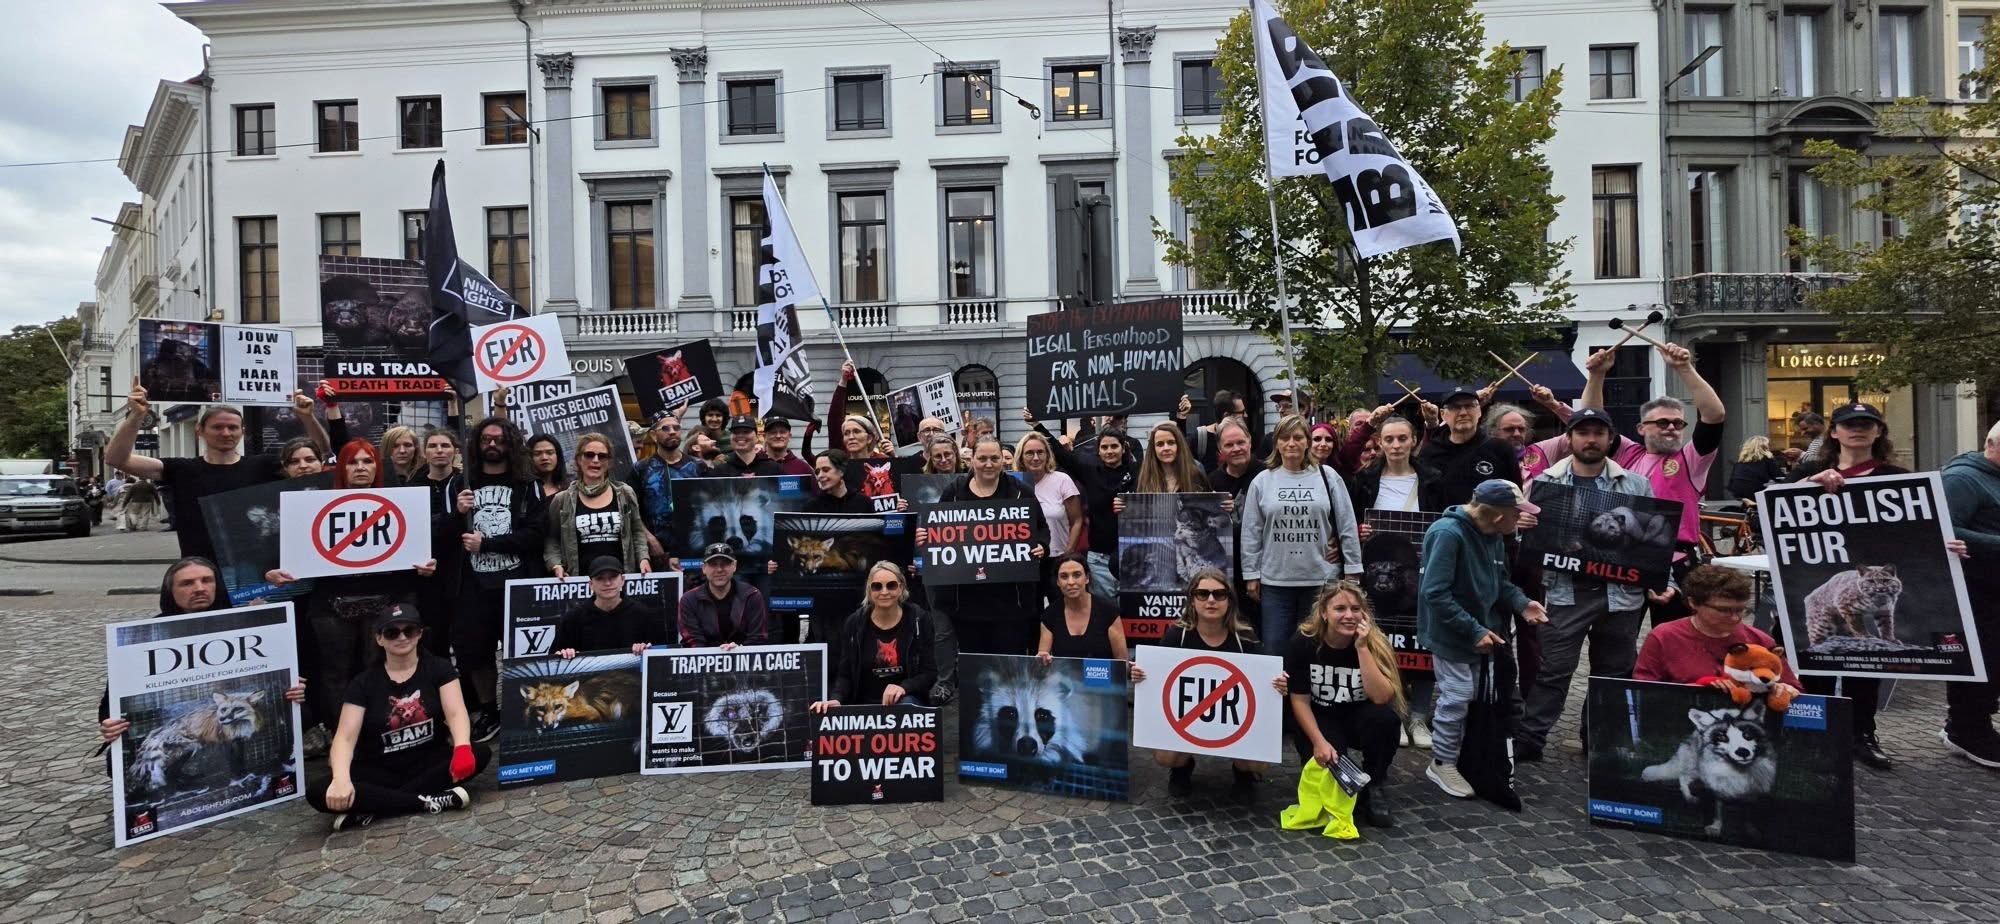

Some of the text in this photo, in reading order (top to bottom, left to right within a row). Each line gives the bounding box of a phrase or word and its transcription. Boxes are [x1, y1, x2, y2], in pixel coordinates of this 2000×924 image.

[238, 330, 279, 342] JOUW
[1029, 332, 1077, 357] LEGAL
[246, 343, 271, 355] JAS
[485, 336, 536, 370] FUR
[337, 362, 440, 375] FUR TRAD
[1051, 347, 1181, 382] FOR NON-HUMAN
[240, 368, 279, 380] HAAR
[239, 381, 281, 392] LEVEN
[338, 380, 441, 390] DEATH TRADE
[665, 382, 696, 401] BAM
[925, 380, 945, 393] JOUW
[931, 391, 943, 400] JAS
[530, 403, 566, 422] FOXES
[568, 393, 612, 411] BELONG
[542, 410, 609, 435] IN THE WILD
[874, 498, 896, 512] AM
[1283, 505, 1309, 516] FOR
[1774, 486, 1933, 529] ABOLISH
[576, 511, 622, 528] BITE
[927, 506, 1030, 524] ANIMALS ARE
[1272, 519, 1320, 529] ANIMAL
[329, 511, 392, 549] FUR
[927, 523, 1031, 544] NOT OURS
[1273, 532, 1319, 543] RIGHTS
[927, 543, 1031, 565] TO WEAR
[1778, 530, 1849, 565] FUR
[1543, 553, 1640, 581] FUR KILLS
[626, 580, 659, 596] CAGE
[1139, 607, 1161, 617] NO
[1130, 623, 1158, 633] FOR
[144, 634, 268, 677] DIOR
[671, 652, 801, 674] TRAPPED IN A CAGE
[145, 663, 268, 689] KILLING WILDLIFE FOR FASHION
[1310, 664, 1363, 688] BITE
[1178, 676, 1240, 726] FUR
[1788, 708, 1821, 717] RIGHTS
[819, 713, 936, 731] ANIMALS ARE
[819, 732, 936, 755] NOT OURS
[501, 764, 553, 776] WEG MET BONT
[819, 757, 936, 781] TO WEAR
[961, 765, 1005, 775] WEG MET BONT
[180, 792, 253, 817] ABOLISHFUR.COM
[1592, 804, 1659, 819] WEG MET BONT
